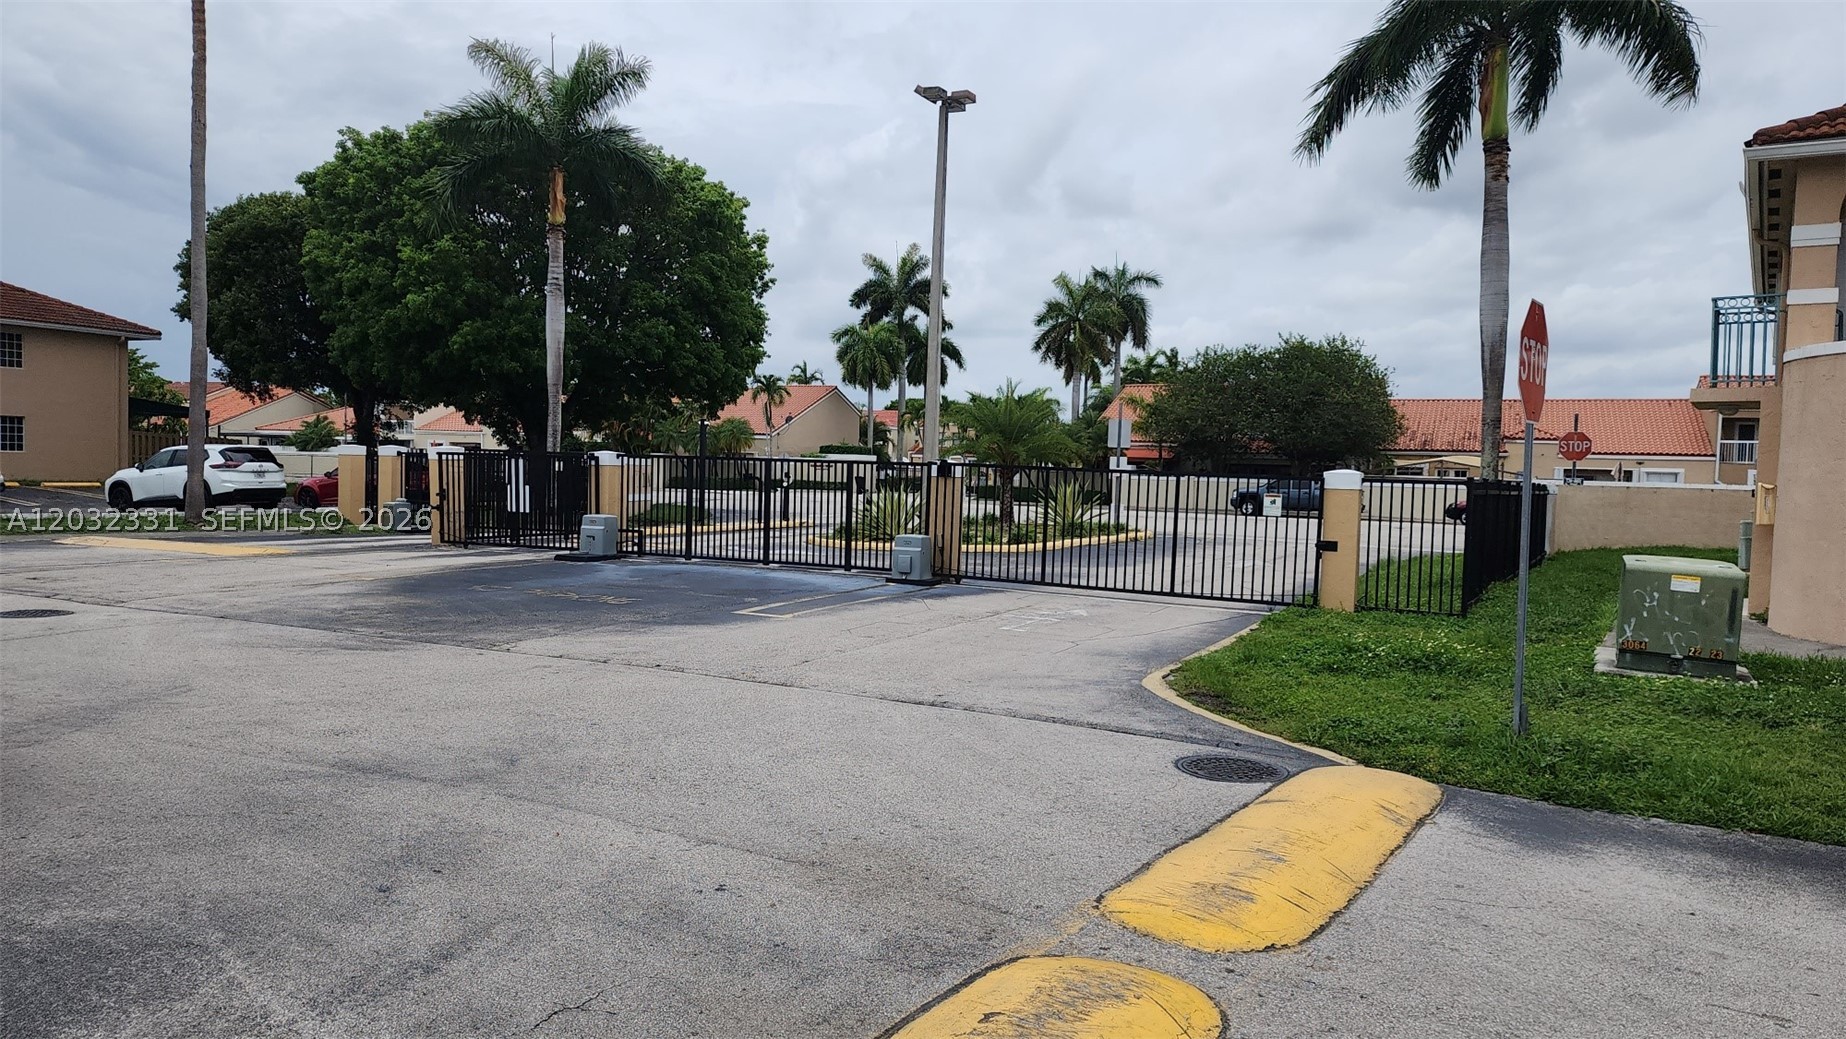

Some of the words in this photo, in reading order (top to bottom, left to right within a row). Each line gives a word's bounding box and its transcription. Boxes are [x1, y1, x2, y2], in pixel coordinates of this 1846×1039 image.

[1520, 336, 1548, 387] STOP
[1560, 440, 1591, 452] STOP
[1622, 640, 1646, 650] 3064
[1689, 647, 1701, 656] 22
[1710, 650, 1723, 660] 23
